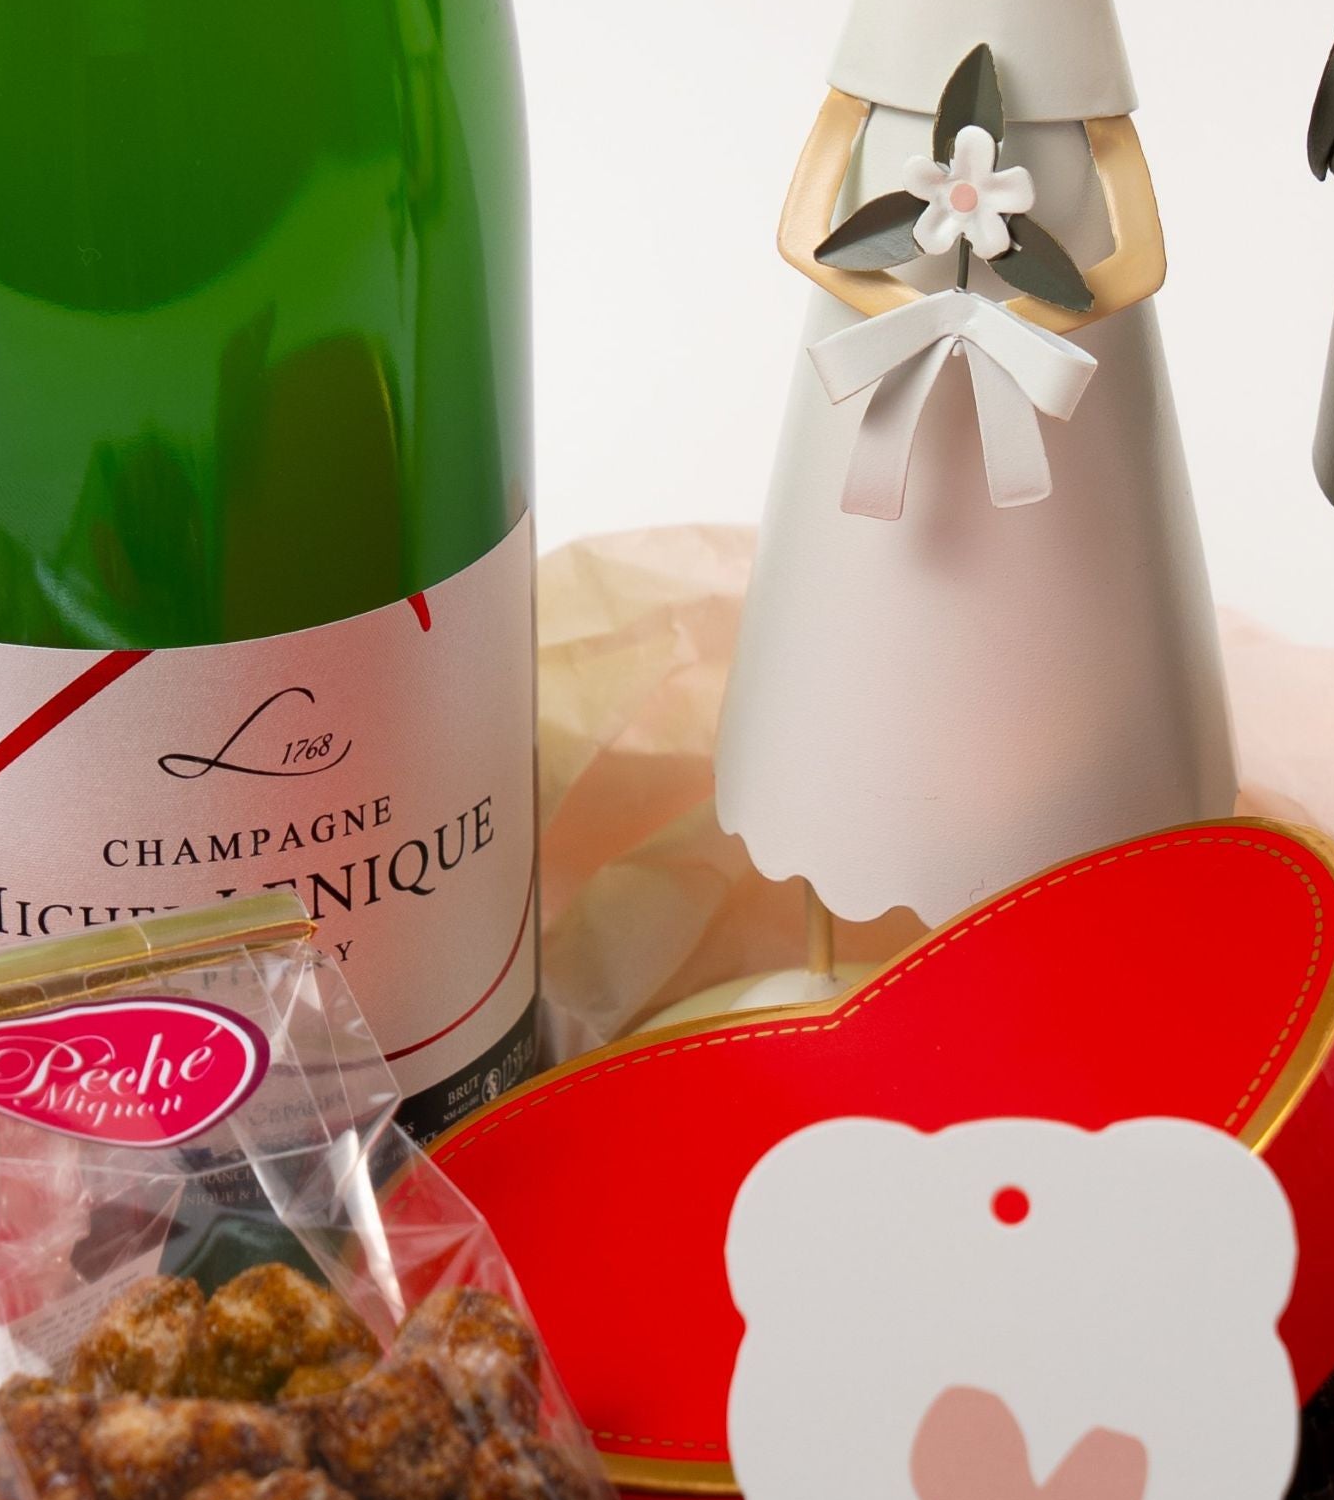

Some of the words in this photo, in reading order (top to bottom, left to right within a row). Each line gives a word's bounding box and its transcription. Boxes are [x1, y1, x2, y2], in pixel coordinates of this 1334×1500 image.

[280, 733, 334, 766] 1768
[102, 796, 393, 867] CHAMPAGNE
[216, 796, 495, 920] NIQUE
[19, 1085, 183, 1127] Mignon
[448, 1074, 482, 1105] BRUT
